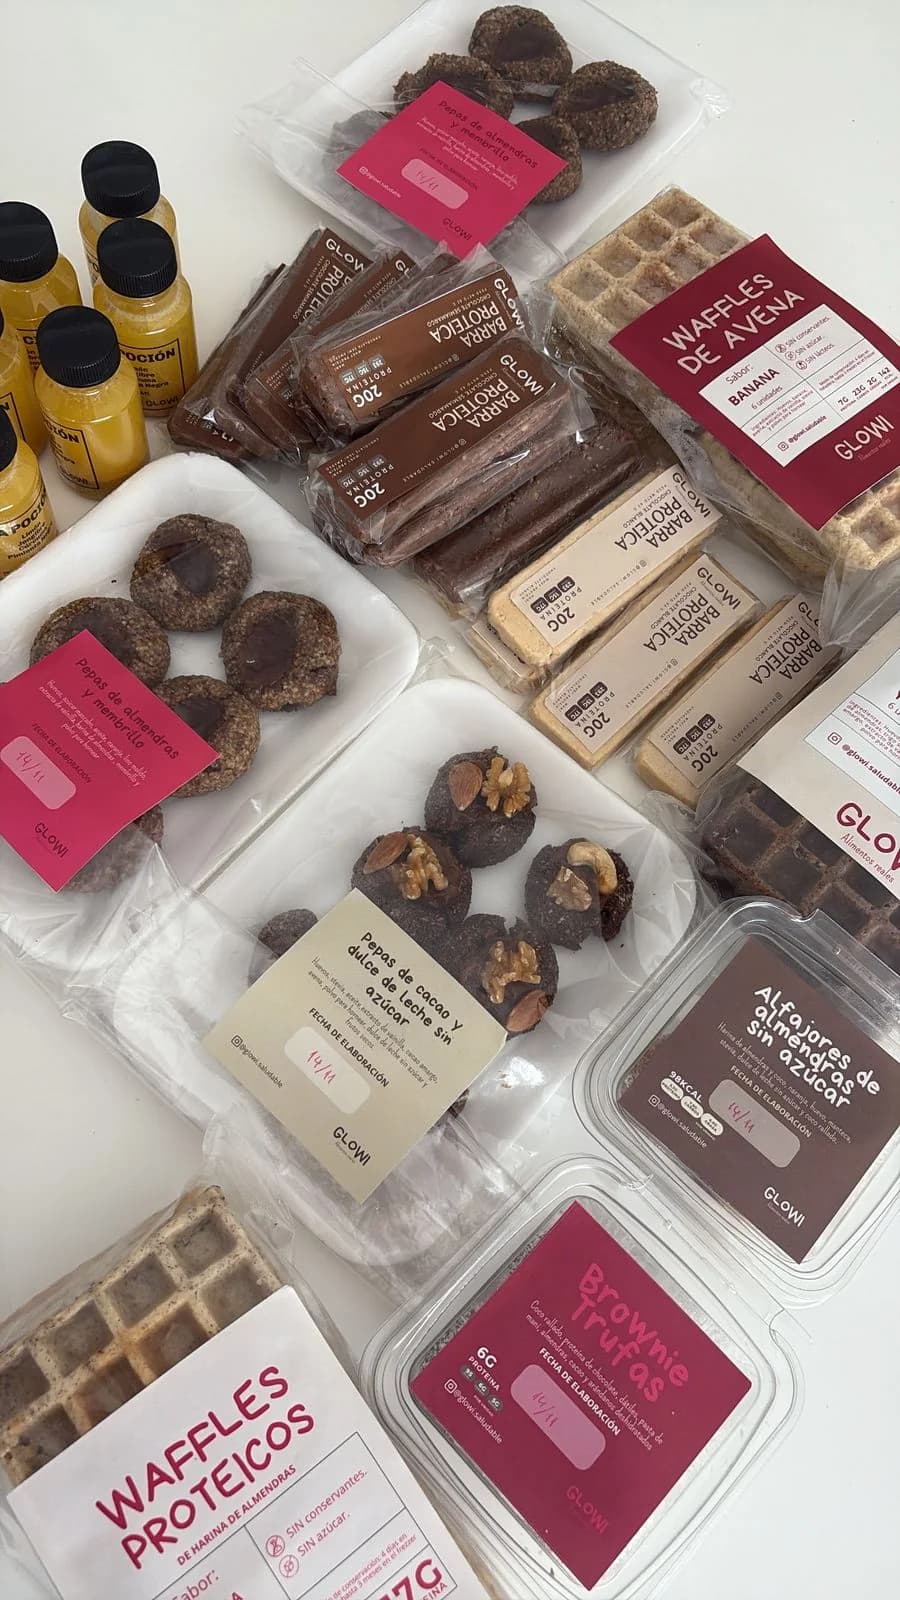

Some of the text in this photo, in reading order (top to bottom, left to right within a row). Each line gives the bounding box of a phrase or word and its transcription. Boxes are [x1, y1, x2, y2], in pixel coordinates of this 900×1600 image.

[438, 100, 538, 168] Pepas de almendras
[449, 120, 509, 161] y membrillo
[442, 217, 472, 240] GLOWI
[326, 238, 364, 272] GLOW
[428, 300, 499, 342] PROTEICA
[494, 278, 525, 329] GLOWI
[662, 274, 773, 349] WAFFLES
[459, 315, 507, 347] BARRA
[677, 289, 804, 374] DE AVENA
[784, 337, 797, 347] SIN
[794, 344, 806, 355] SIN
[352, 384, 382, 407] 20G
[500, 354, 544, 396] GLOWI
[724, 363, 753, 384] Sabor:
[728, 368, 779, 406] BANANA
[431, 378, 508, 430] PROTEICA
[466, 389, 520, 427] BARRA
[750, 385, 783, 410] 6 unidades
[836, 395, 849, 406] 7G
[834, 414, 893, 459] GLOWI
[353, 482, 385, 507] 20G
[672, 472, 711, 518] GLOWI
[614, 496, 682, 550] PROTEICA
[645, 508, 692, 548] BARRA
[697, 567, 742, 610] GLOWI
[546, 606, 575, 632] 20G
[643, 592, 708, 651] PROTEICA
[674, 604, 720, 645] BARRA
[749, 626, 810, 683] PROTEICA
[778, 638, 822, 679] BARRA
[75, 657, 108, 690] Pepas
[106, 688, 124, 706] de
[123, 706, 179, 759] almendras
[81, 688, 144, 748] y membrillo
[582, 711, 610, 738] 20G
[690, 744, 718, 772] 20G
[34, 822, 68, 858] GLOWI
[836, 802, 900, 871] GLO
[840, 833, 895, 883] Alimentos reales
[347, 945, 451, 1045] dulce de leche sin
[360, 931, 463, 1031] Pepas de cacao y
[365, 986, 410, 1025] azúcar
[308, 1007, 389, 1087] FECHA DE ELABORACIÓN
[746, 1019, 850, 1106] sin azúcar
[754, 987, 883, 1096] Alfajores de
[755, 1000, 860, 1094] almendras
[306, 1050, 336, 1084] 14/11
[669, 1070, 701, 1103] 98KCAL
[727, 1100, 755, 1133] 14/11
[729, 1064, 812, 1137] FECHA DE ELABORACIÓN
[332, 1126, 371, 1165] GLOWI
[763, 1186, 805, 1227] GLOWI
[571, 1291, 673, 1401] Trufas
[579, 1263, 688, 1386] Brownie
[468, 1355, 499, 1391] PROTEINA
[476, 1346, 497, 1368] 6G
[528, 1298, 547, 1319] Coco
[583, 1356, 596, 1370] de
[591, 1367, 618, 1399] chocolate,
[637, 1418, 655, 1437] pasta
[653, 1431, 665, 1445] de
[538, 1347, 620, 1435] FECHA DE ELABORACIÓN
[567, 1359, 585, 1378] cacao
[580, 1376, 588, 1384] y
[614, 1407, 652, 1450] deshidratados
[453, 1389, 502, 1444] @glowi.saludable
[96, 1367, 287, 1528] WAFFLES
[122, 1404, 313, 1568] PROTEICOS
[285, 1469, 367, 1539] SIN conservantes.
[176, 1464, 296, 1566] DE HARINA DE ALMENDRAS
[566, 1485, 609, 1533] GLOWI
[296, 1511, 350, 1557] SIN azúcar.
